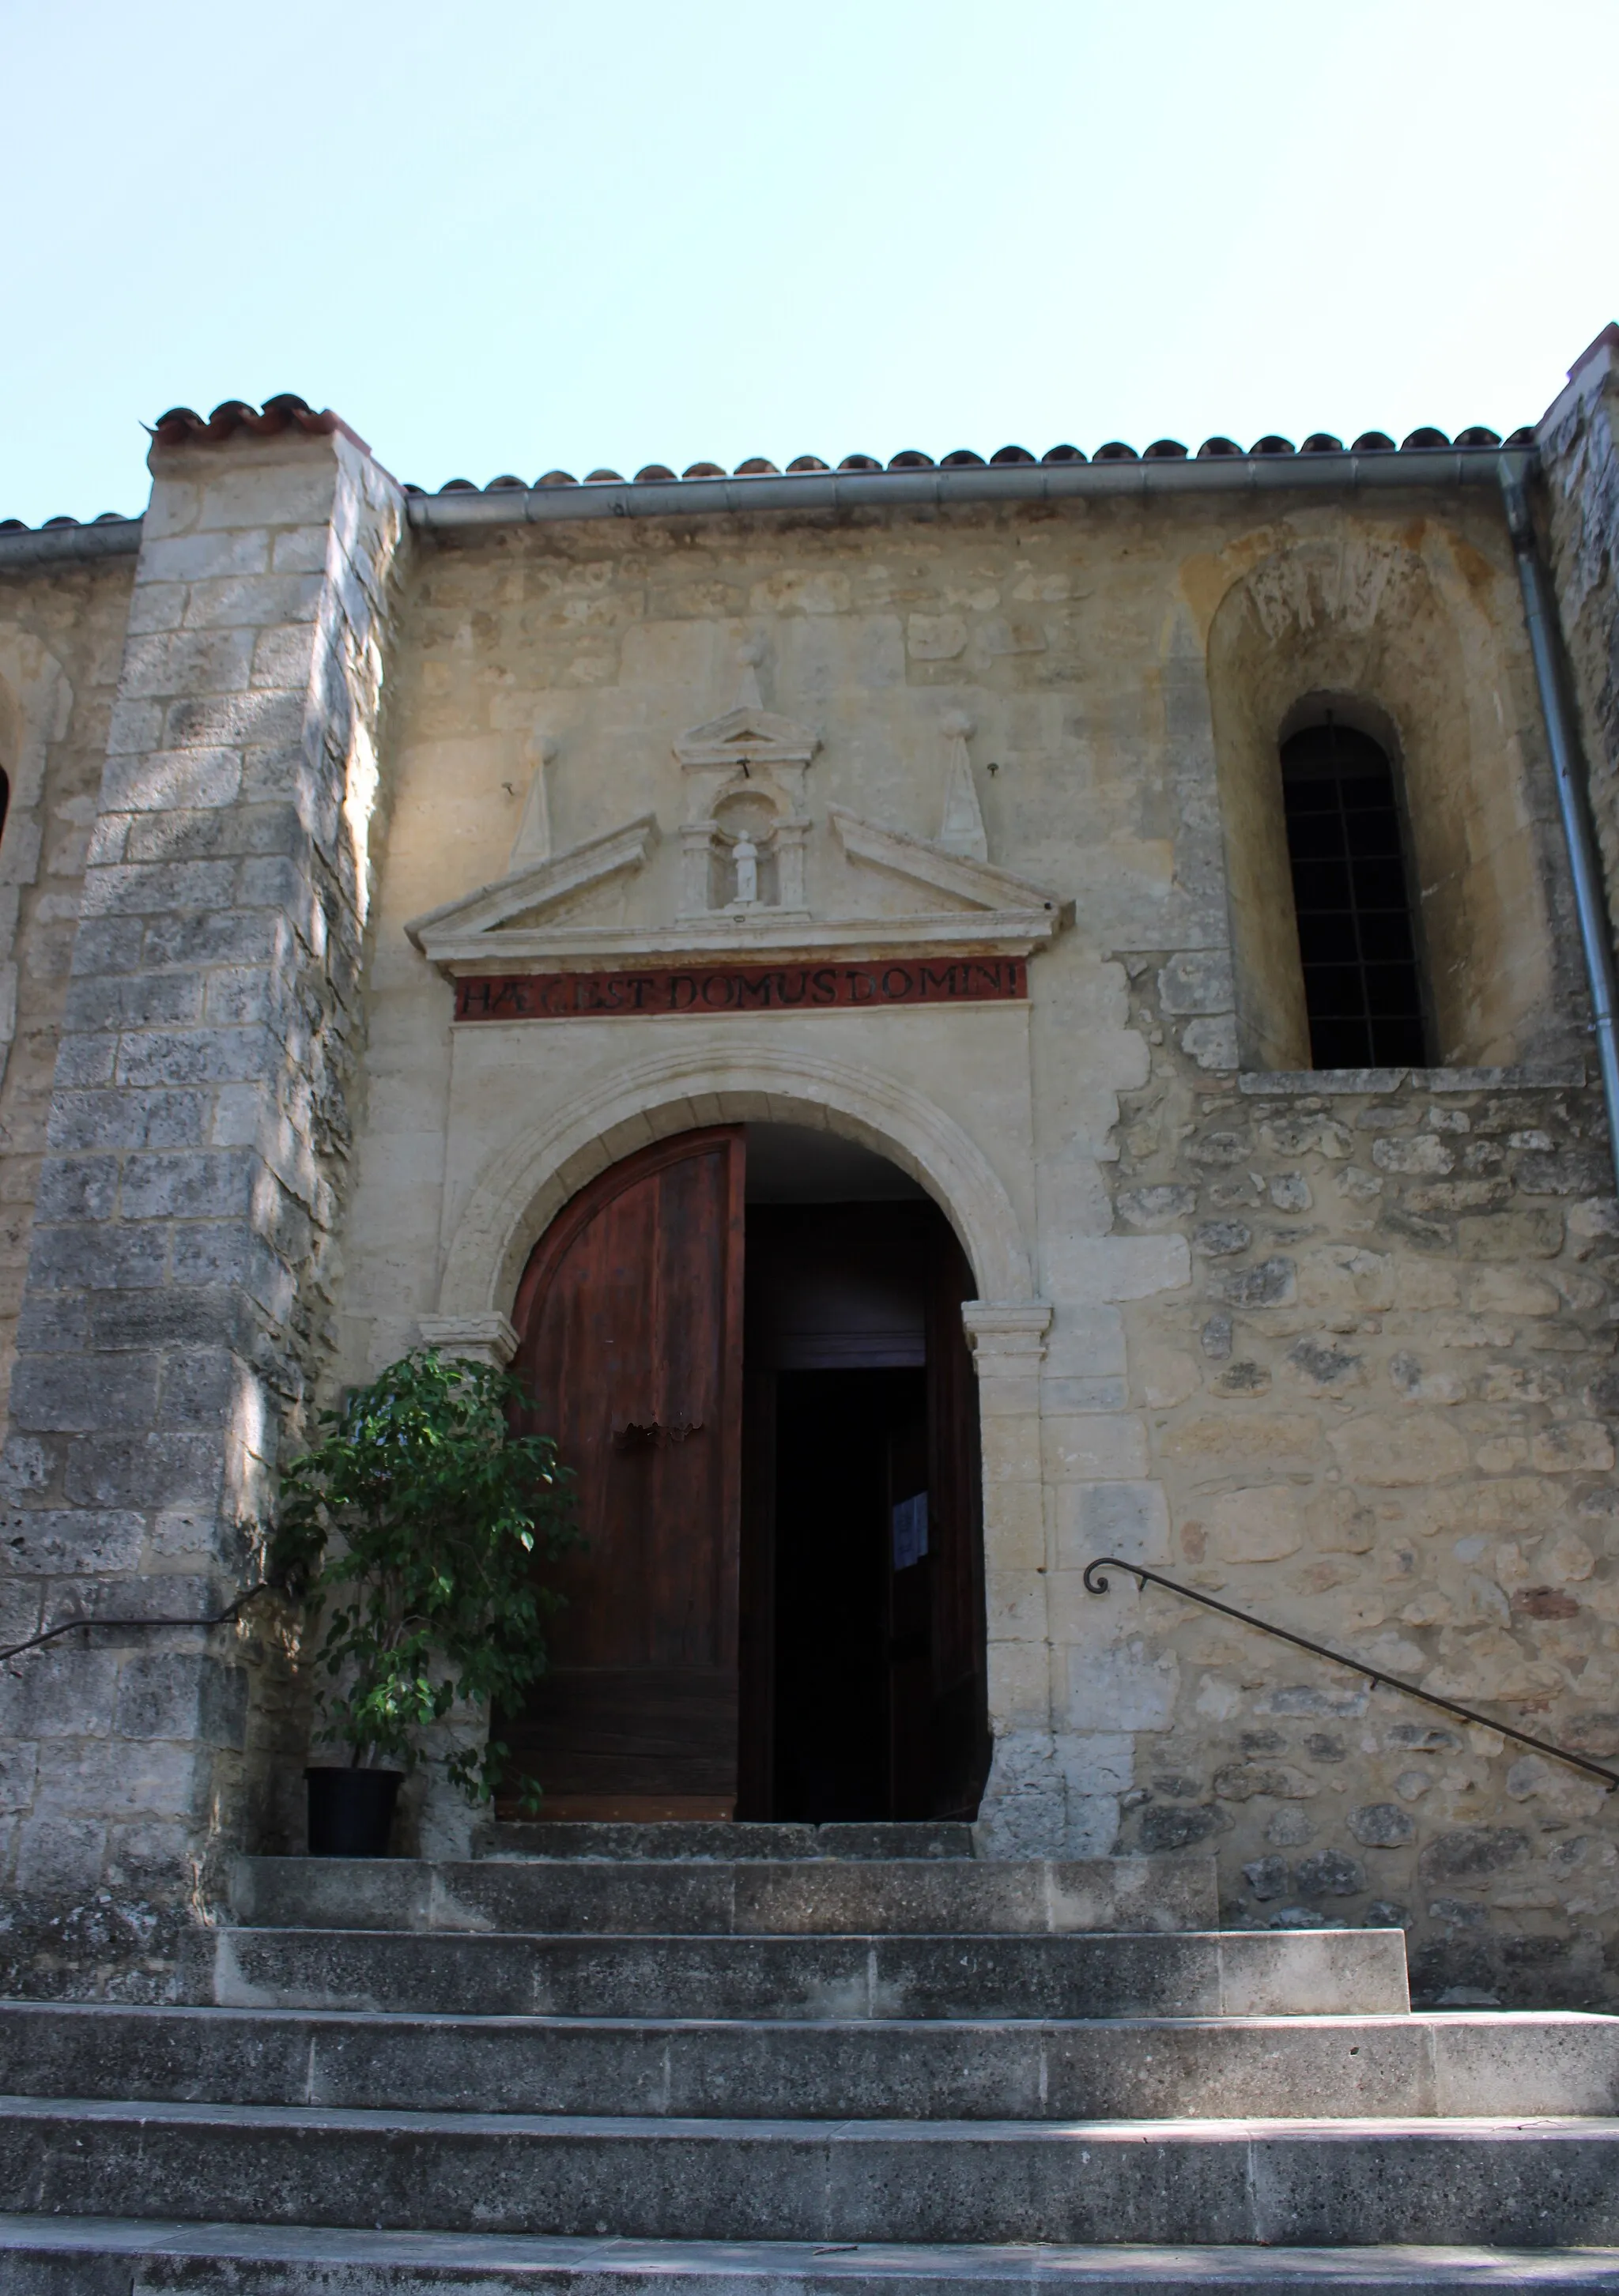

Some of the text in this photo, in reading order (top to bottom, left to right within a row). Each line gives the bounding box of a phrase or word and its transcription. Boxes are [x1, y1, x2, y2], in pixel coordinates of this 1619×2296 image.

[576, 978, 653, 1011] EST
[669, 969, 836, 1009] DOMUS
[847, 963, 1017, 1001] DOMINI
